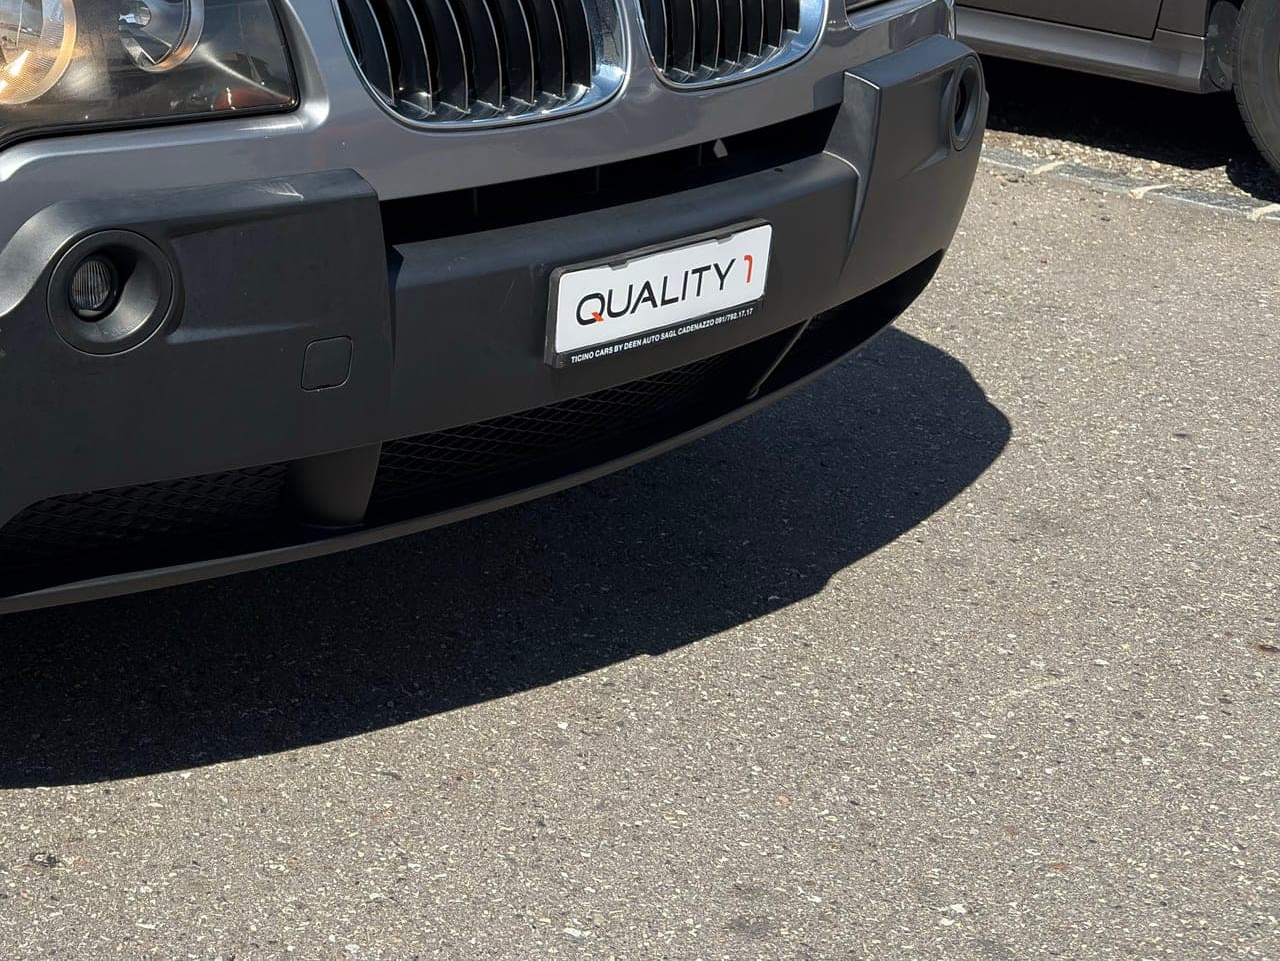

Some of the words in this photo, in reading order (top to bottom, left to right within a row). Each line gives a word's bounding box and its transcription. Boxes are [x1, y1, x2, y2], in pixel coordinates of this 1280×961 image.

[576, 258, 737, 326] QUALITY
[743, 254, 753, 283] 1
[570, 351, 595, 364] TICINO
[595, 346, 613, 358] CARS
[614, 344, 624, 353] BY
[624, 340, 642, 350] DEEN
[642, 334, 660, 345] AUTO
[660, 329, 677, 341] SAGL
[678, 318, 715, 336] CADENAZZO
